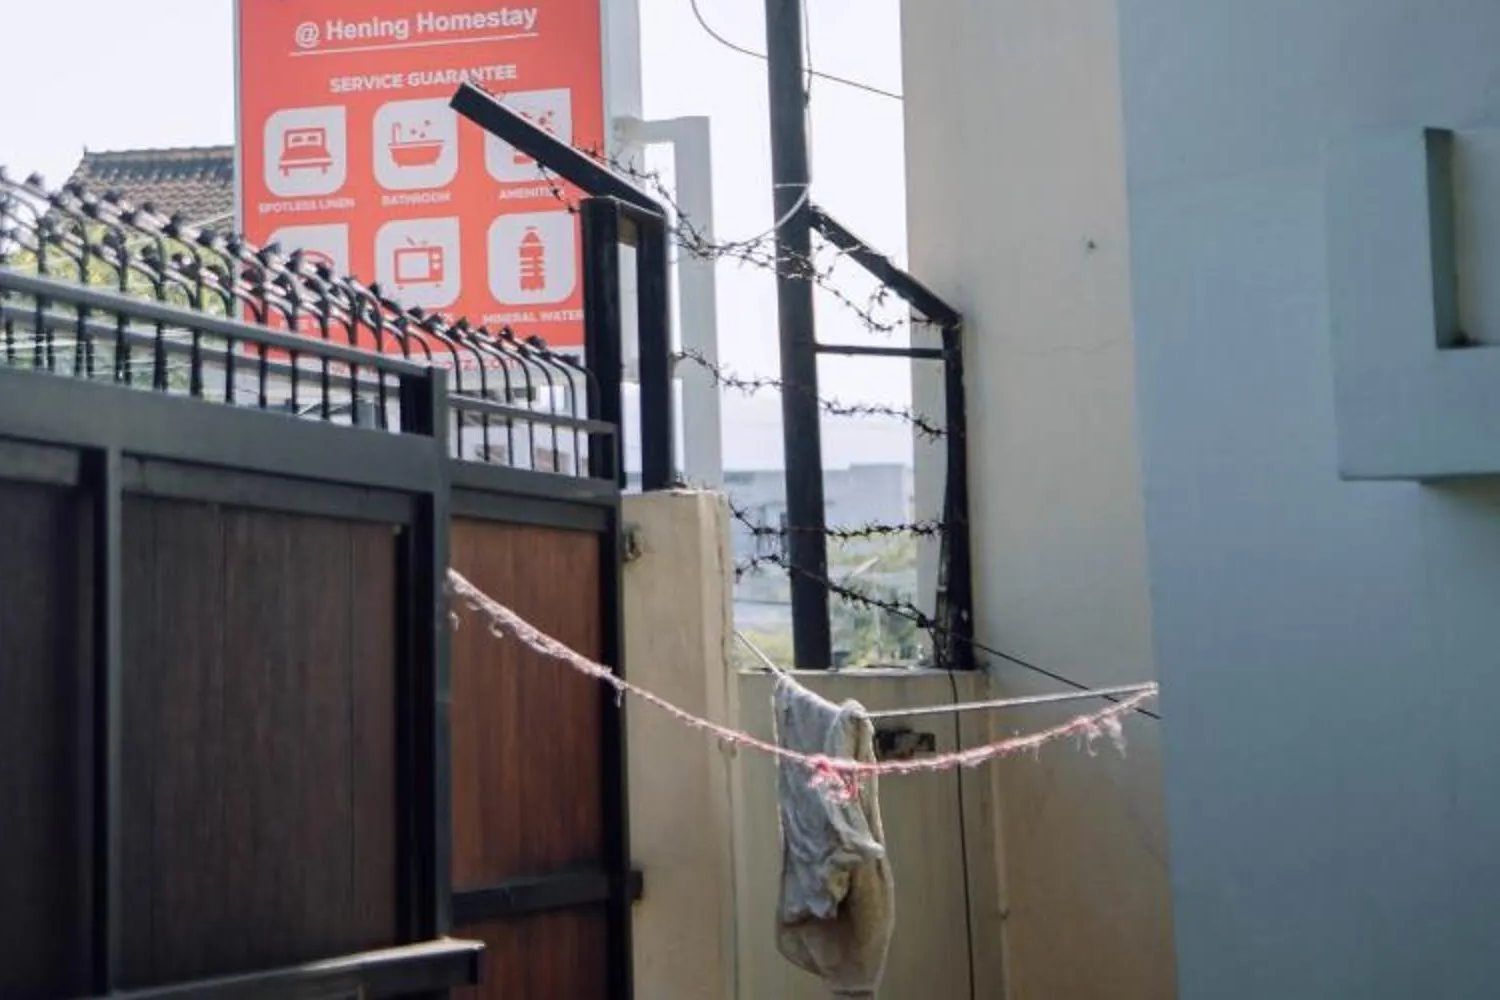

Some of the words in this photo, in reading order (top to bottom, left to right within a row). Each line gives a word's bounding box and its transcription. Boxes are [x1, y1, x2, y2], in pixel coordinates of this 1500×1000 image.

[325, 15, 410, 41] Hening
[416, 7, 538, 34] Homestay
[329, 73, 404, 93] SERVICE
[407, 64, 517, 87] GUARANTEE
